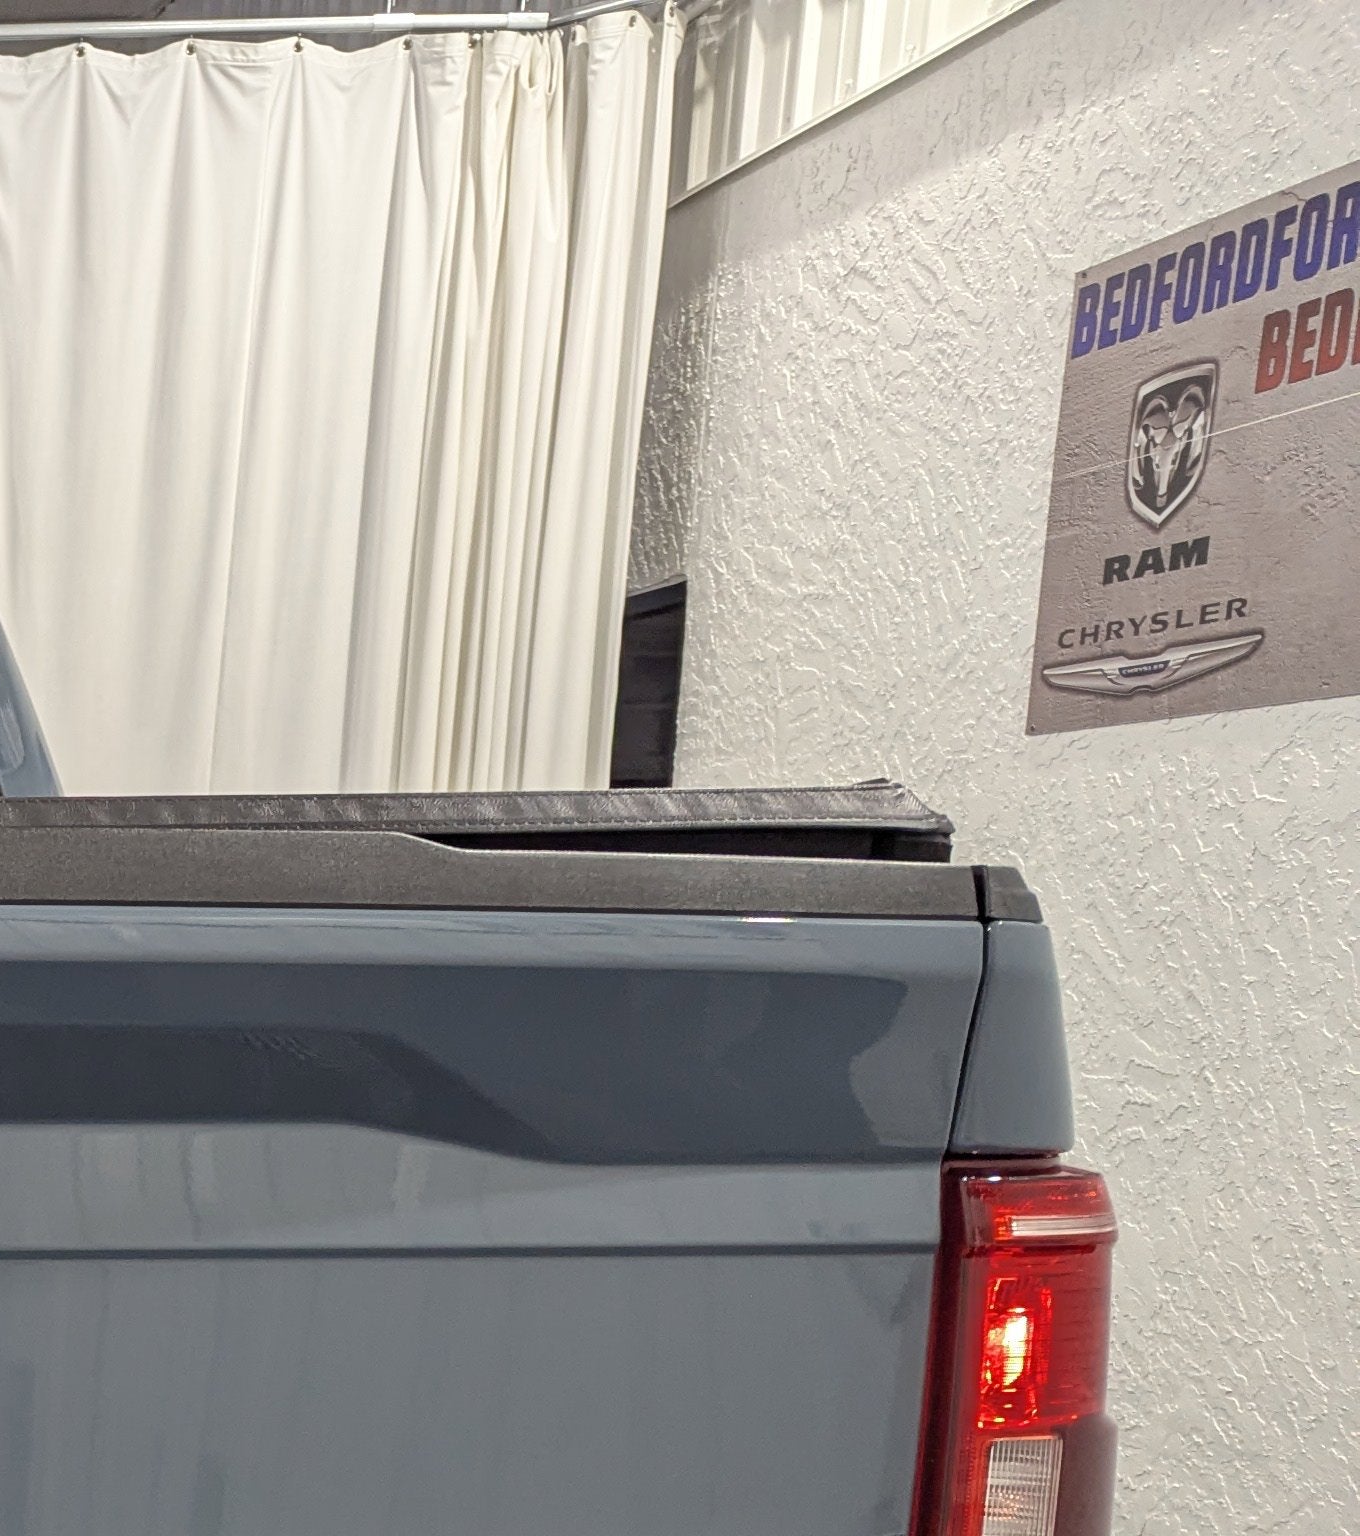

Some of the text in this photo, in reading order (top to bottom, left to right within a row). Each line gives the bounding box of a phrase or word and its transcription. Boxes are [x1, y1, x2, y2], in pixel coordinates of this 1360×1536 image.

[1254, 287, 1360, 393] BED
[1103, 536, 1210, 586] RAM
[1057, 597, 1248, 649] CHRYSLER
